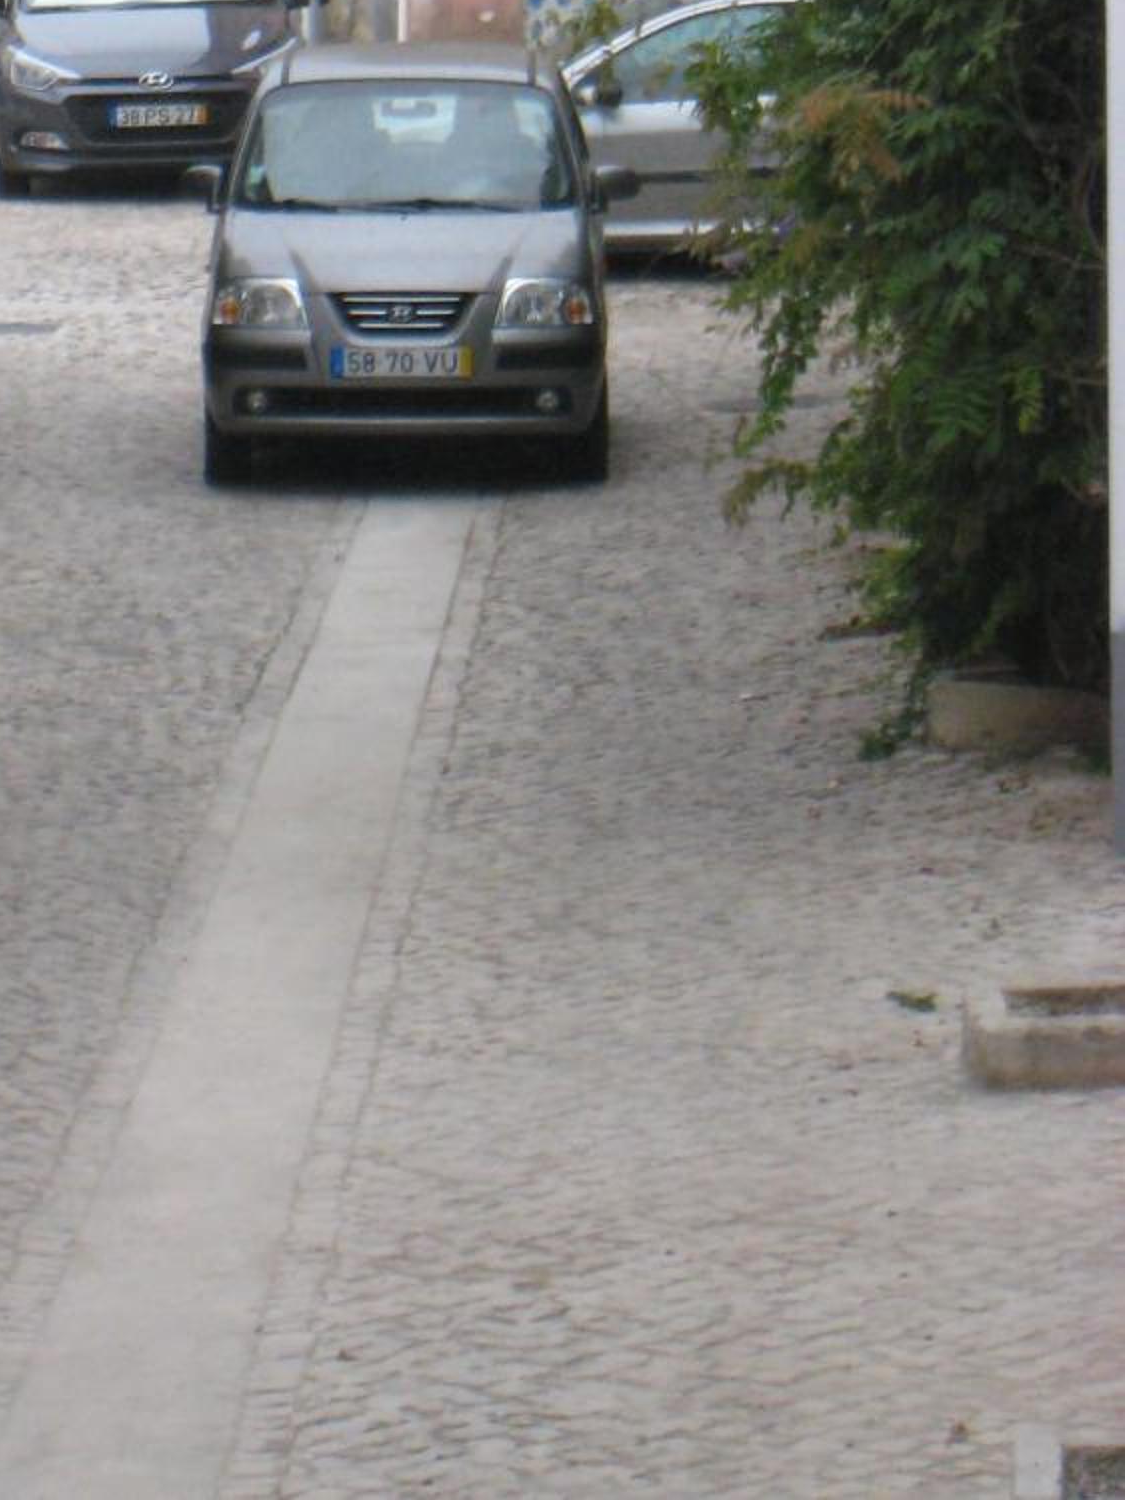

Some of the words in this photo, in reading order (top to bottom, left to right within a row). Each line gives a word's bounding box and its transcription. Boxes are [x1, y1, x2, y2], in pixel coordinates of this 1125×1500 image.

[144, 107, 170, 124] PS
[347, 352, 376, 373] 58
[384, 352, 414, 373] 70
[425, 352, 459, 373] VU
